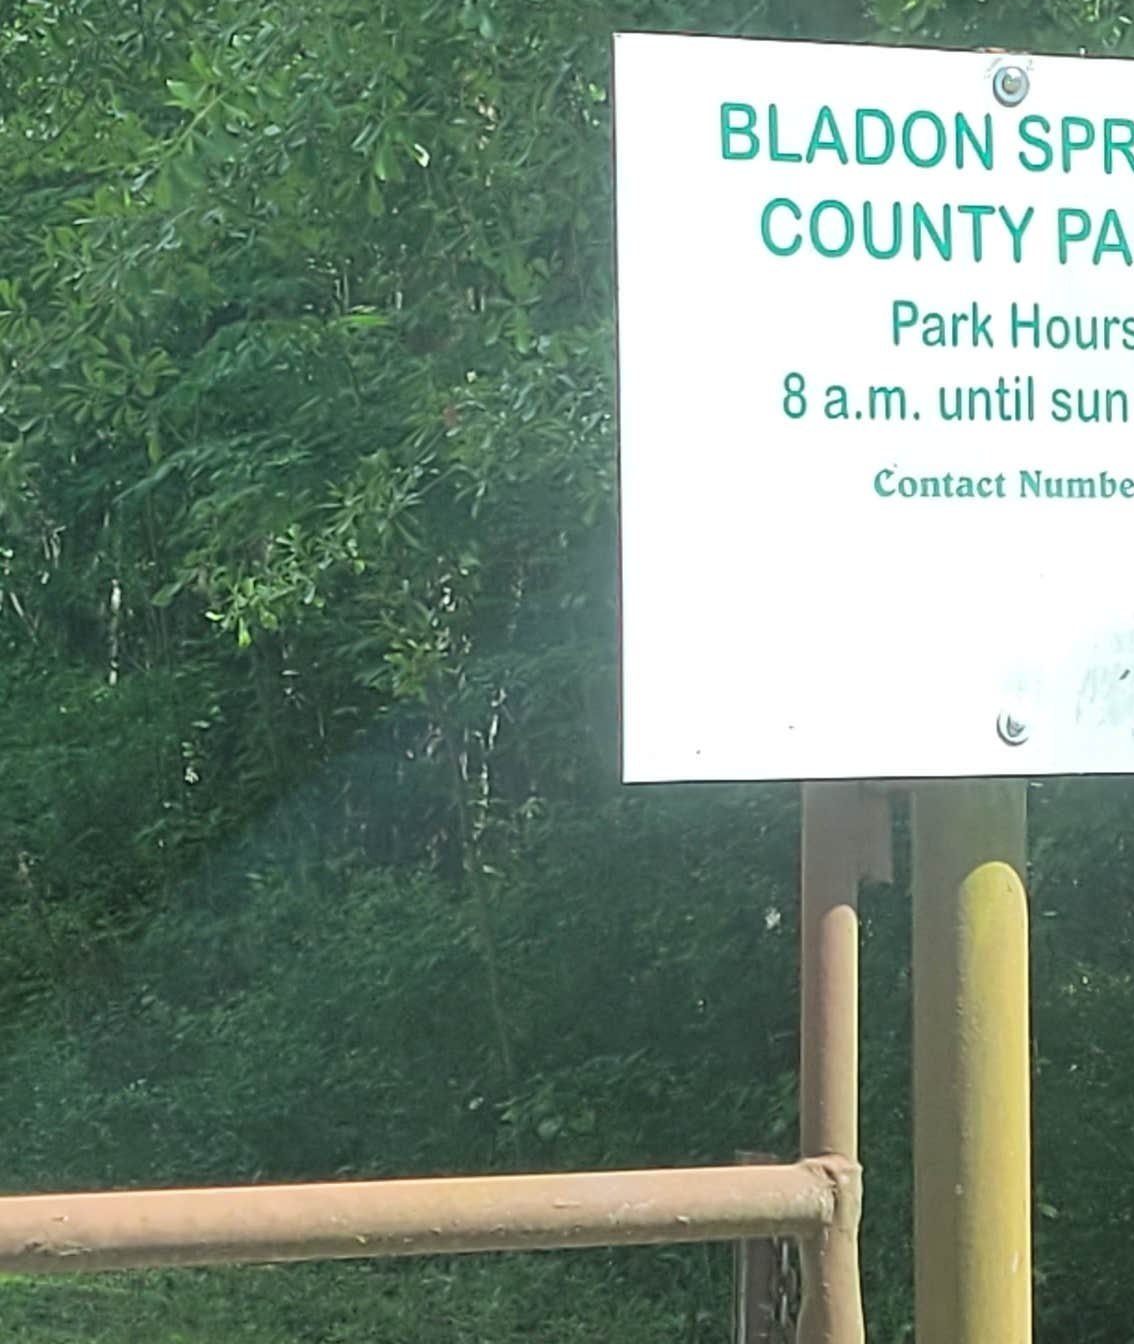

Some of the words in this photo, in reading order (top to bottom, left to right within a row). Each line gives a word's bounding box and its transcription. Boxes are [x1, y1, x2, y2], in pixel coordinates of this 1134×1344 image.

[720, 101, 994, 171] BLADON
[760, 197, 1035, 264] COUNTY
[892, 299, 994, 349] Park
[782, 371, 808, 420] 8
[823, 384, 921, 422] a.m.
[938, 375, 1035, 423] until
[1051, 388, 1128, 423] sun
[873, 468, 1006, 499] Contact
